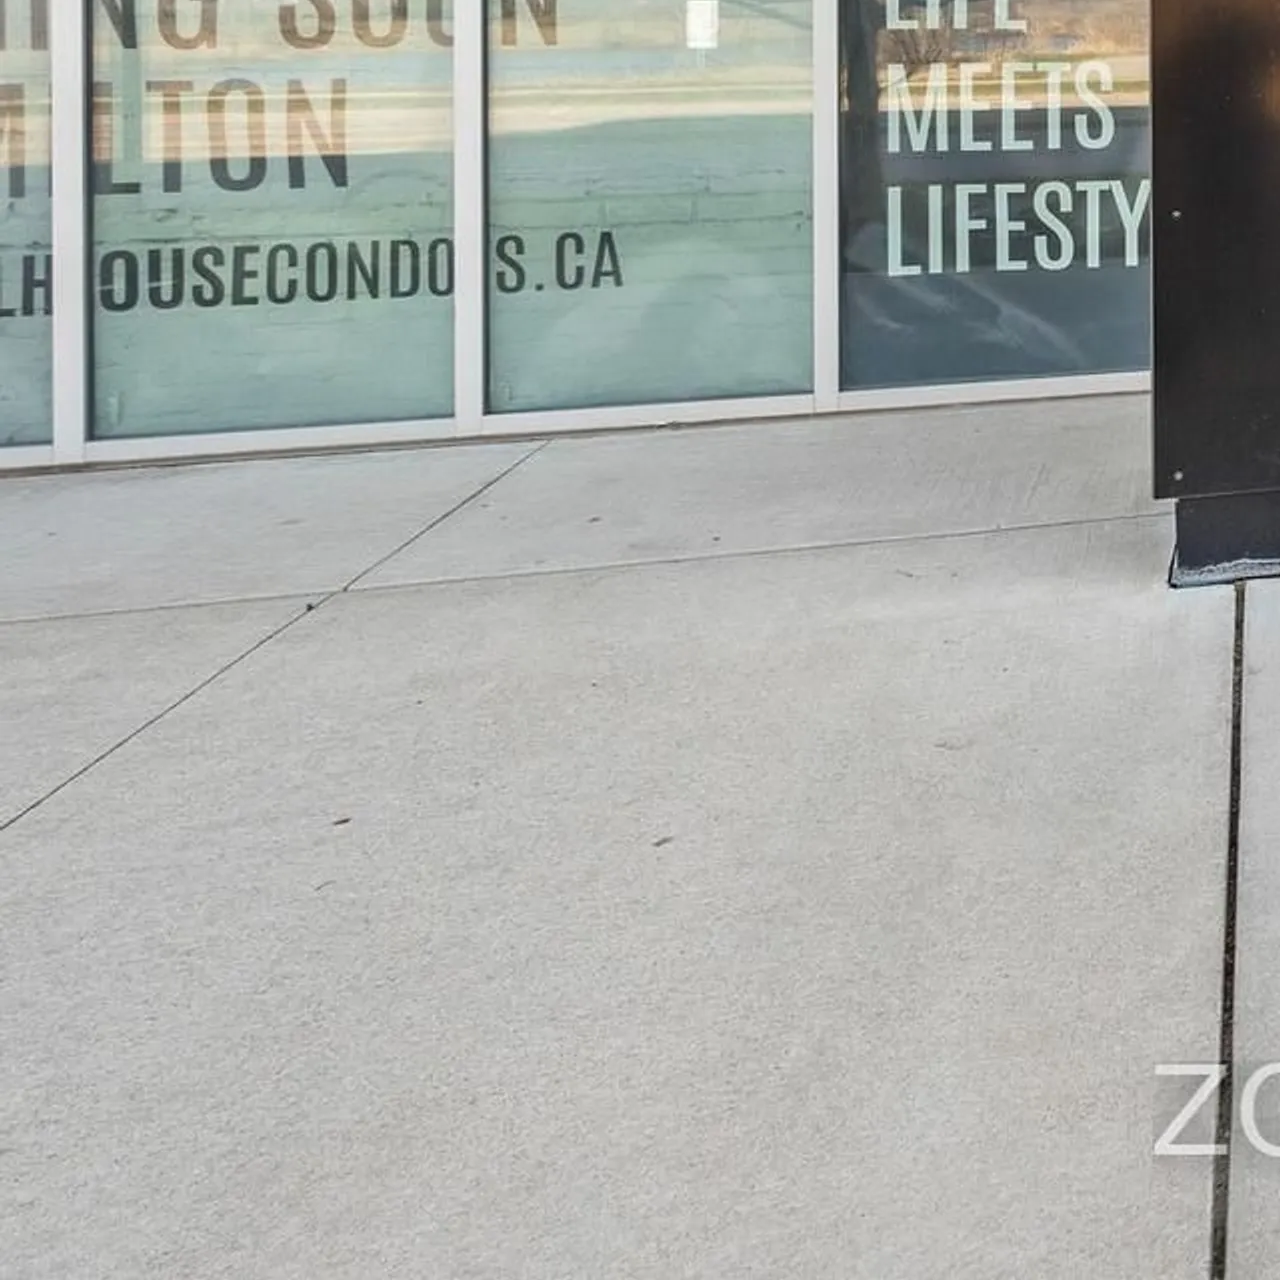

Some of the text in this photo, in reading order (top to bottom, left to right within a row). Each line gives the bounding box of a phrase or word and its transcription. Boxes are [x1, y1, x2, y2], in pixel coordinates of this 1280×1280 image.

[0, 78, 349, 199] LTON
[886, 60, 1114, 153] MEETS
[886, 179, 1151, 277] LIFESTY
